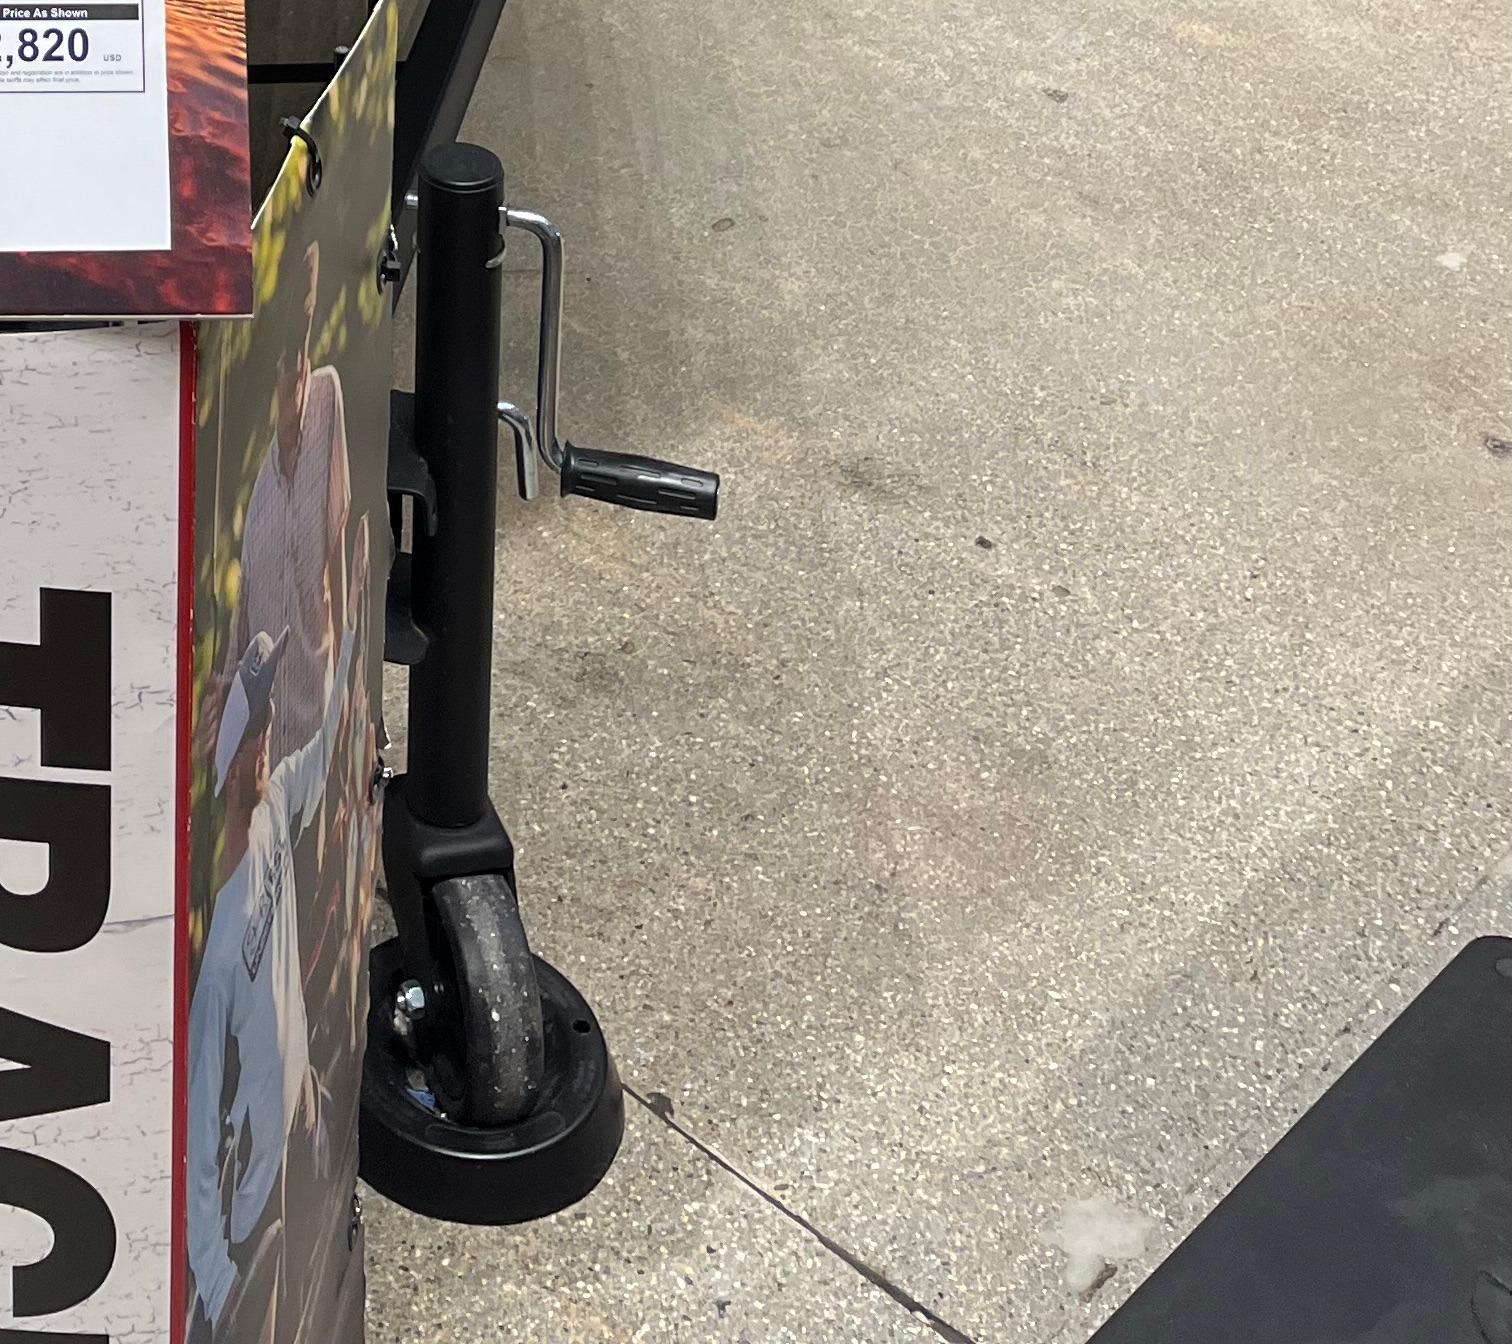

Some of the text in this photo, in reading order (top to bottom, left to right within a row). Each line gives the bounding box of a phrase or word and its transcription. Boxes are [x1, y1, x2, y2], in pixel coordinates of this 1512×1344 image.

[3, 8, 30, 18] Price
[33, 8, 47, 18] As
[50, 7, 88, 18] Shown
[103, 54, 122, 62] USD
